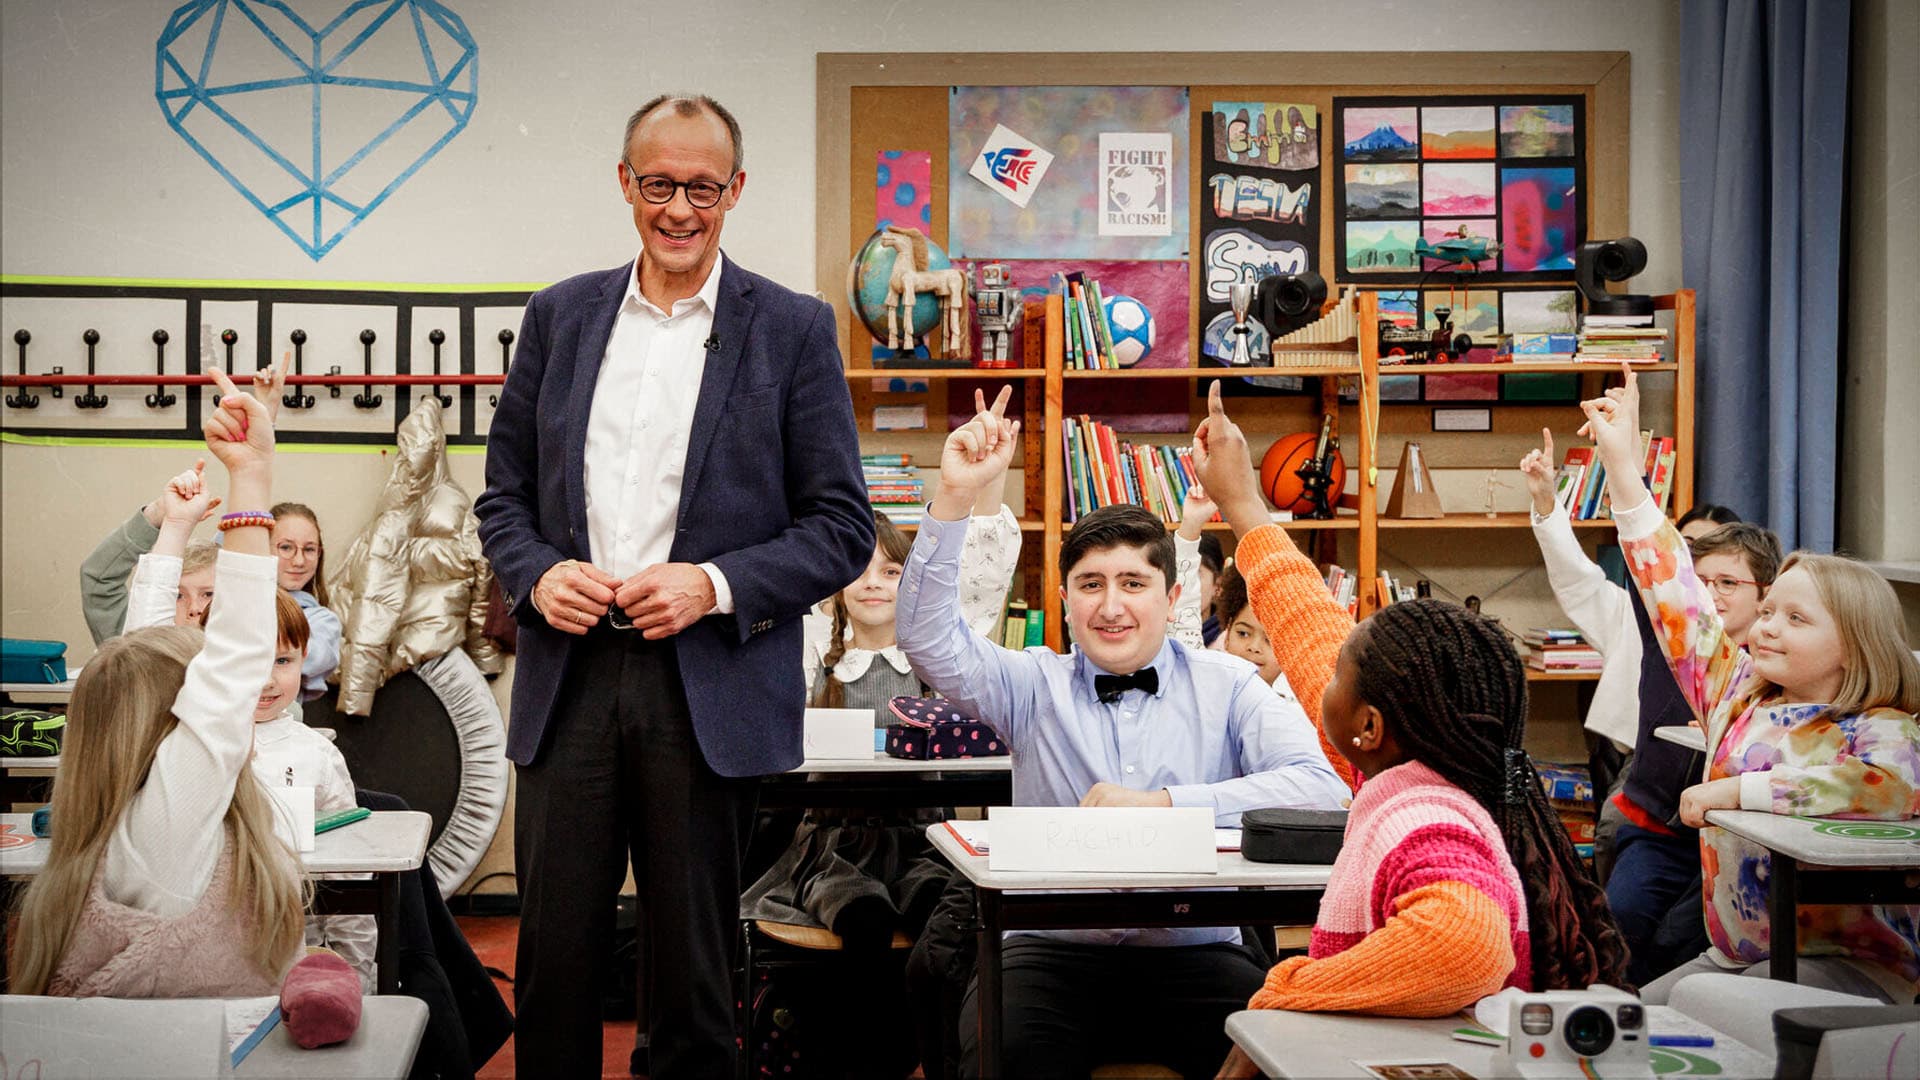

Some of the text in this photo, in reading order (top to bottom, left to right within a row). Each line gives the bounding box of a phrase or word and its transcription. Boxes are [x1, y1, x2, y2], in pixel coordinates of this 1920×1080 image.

[983, 147, 1037, 192] PEACE
[1108, 150, 1167, 166] FIGHT
[1209, 174, 1311, 224] TESLA
[1107, 212, 1167, 225] RACISM!
